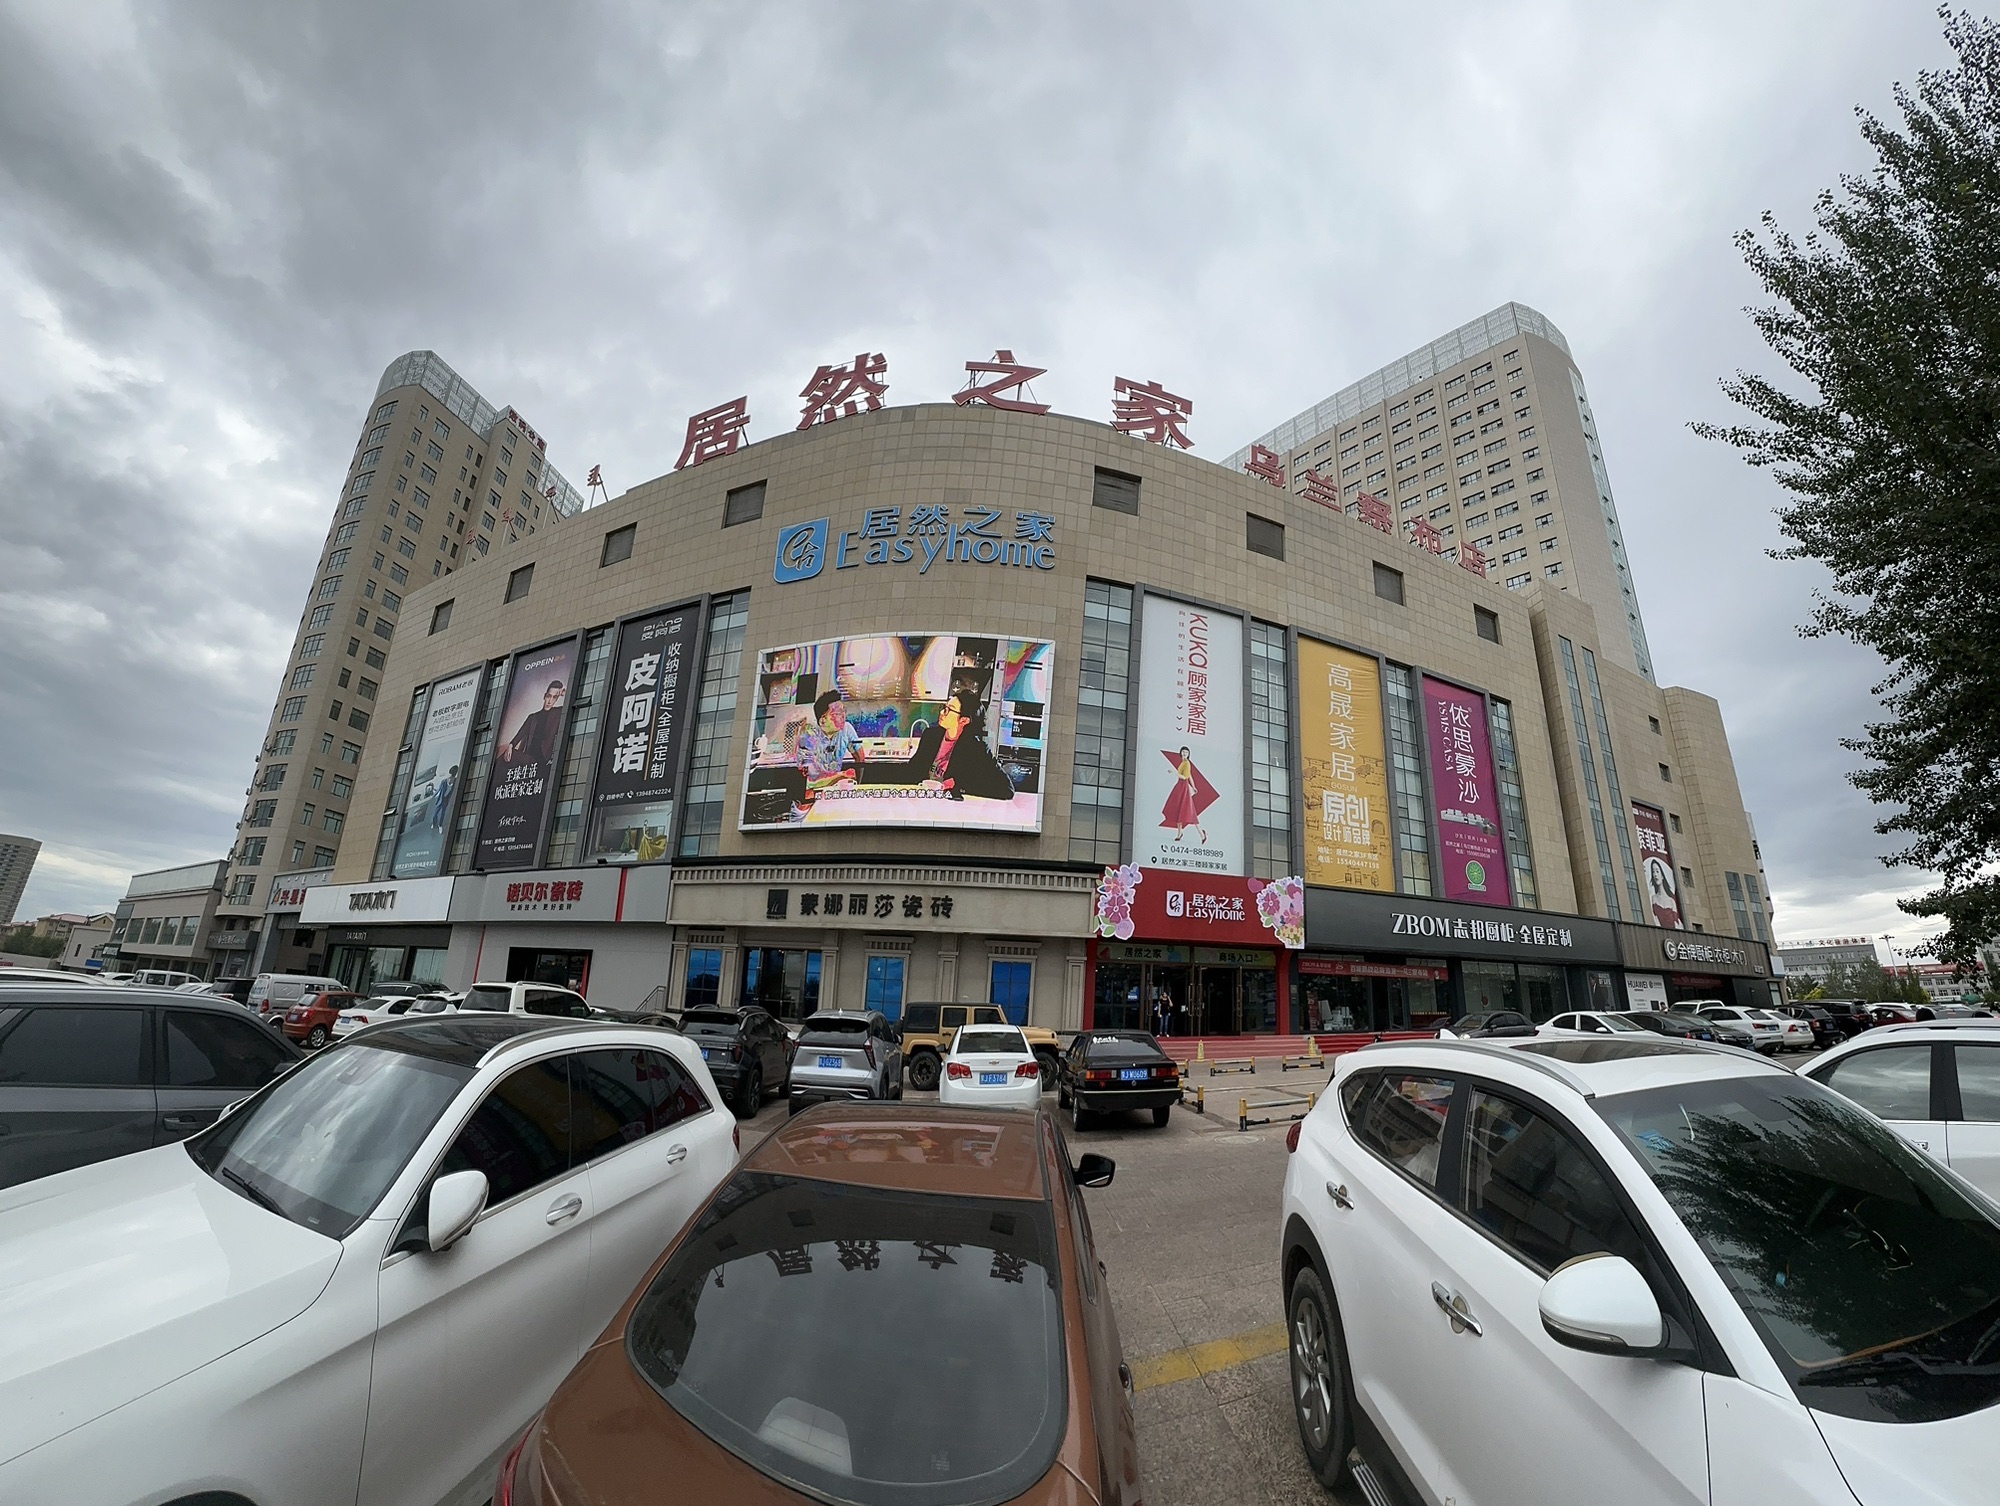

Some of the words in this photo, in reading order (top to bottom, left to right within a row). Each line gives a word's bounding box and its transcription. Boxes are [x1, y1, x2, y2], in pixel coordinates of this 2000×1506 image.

[674, 350, 1195, 471] 居然之家
[859, 503, 1056, 542] 居然之家
[1243, 443, 1487, 579] 乌兰察布店
[836, 523, 1056, 574] Easyhome
[524, 656, 555, 671] OPPEIN
[612, 652, 661, 774] 皮阿诺
[1327, 662, 1356, 782] 高晟家居
[1438, 701, 1450, 733] YSMS
[1443, 736, 1454, 771] CASA
[1449, 703, 1480, 804] 依思蒙沙
[505, 762, 538, 783] 至臻生活
[494, 778, 544, 801] 欧派整家定制
[1331, 781, 1358, 792] GOSUN
[1323, 790, 1370, 829] 原创
[1323, 823, 1370, 846] 设计师品牌
[1170, 845, 1224, 858] 0474-8818989
[349, 890, 398, 911] TATA木门
[506, 880, 584, 904] 诺贝尔瓷砖
[1191, 893, 1244, 911] 居然之家
[800, 893, 954, 919] 蒙娜丽莎瓷砖
[1186, 900, 1246, 924] Easyhome
[1124, 947, 1162, 959] 居然之家
[1219, 951, 1254, 963] 商场入口
